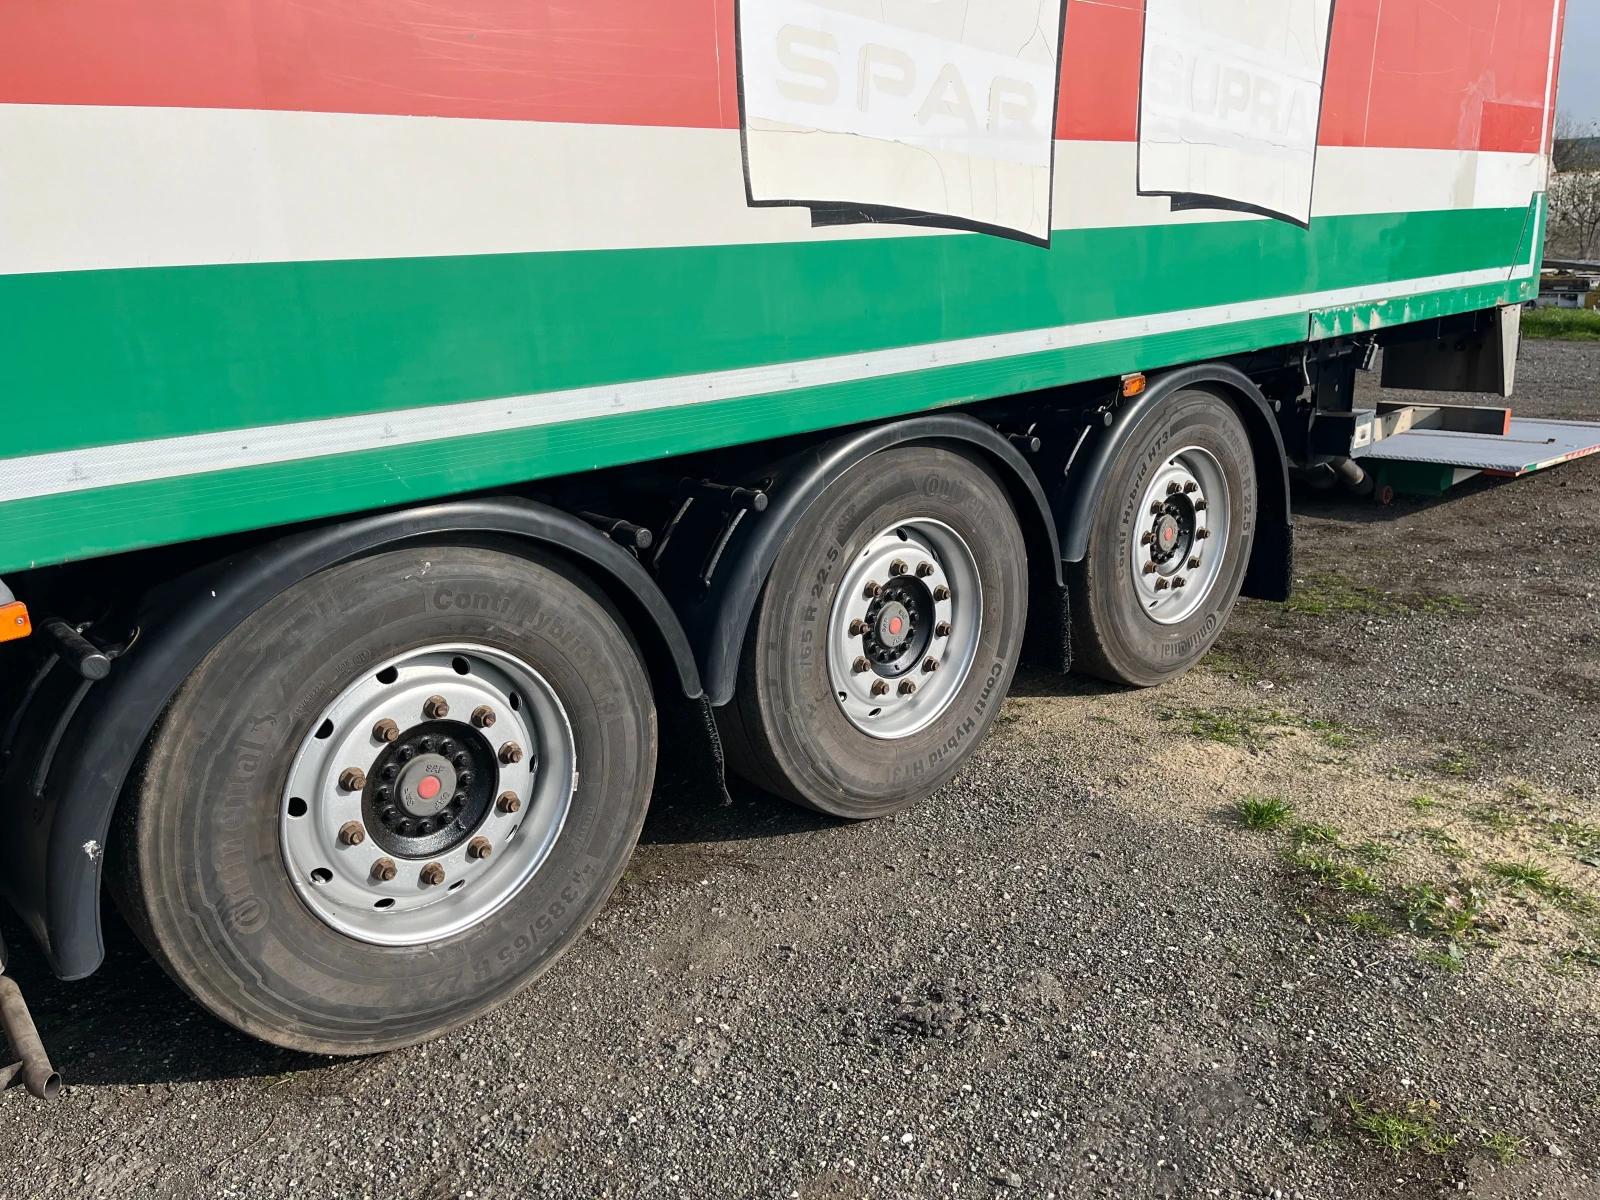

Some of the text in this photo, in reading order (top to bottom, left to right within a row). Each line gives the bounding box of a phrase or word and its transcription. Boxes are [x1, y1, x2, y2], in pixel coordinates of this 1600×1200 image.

[775, 23, 1038, 144] SPAR
[1148, 44, 1314, 146] SUPRA
[1117, 431, 1169, 582] Conti Hybrid HT3
[1242, 477, 1251, 490] R
[1242, 494, 1252, 531] 22.5
[803, 605, 818, 622] R
[811, 548, 839, 599] 22.5
[432, 588, 513, 613] Conti
[512, 597, 596, 665] Hybrid
[1160, 613, 1217, 659] Continental
[892, 662, 1003, 782] Conti Hybrid HT3
[497, 885, 579, 967] 385/65
